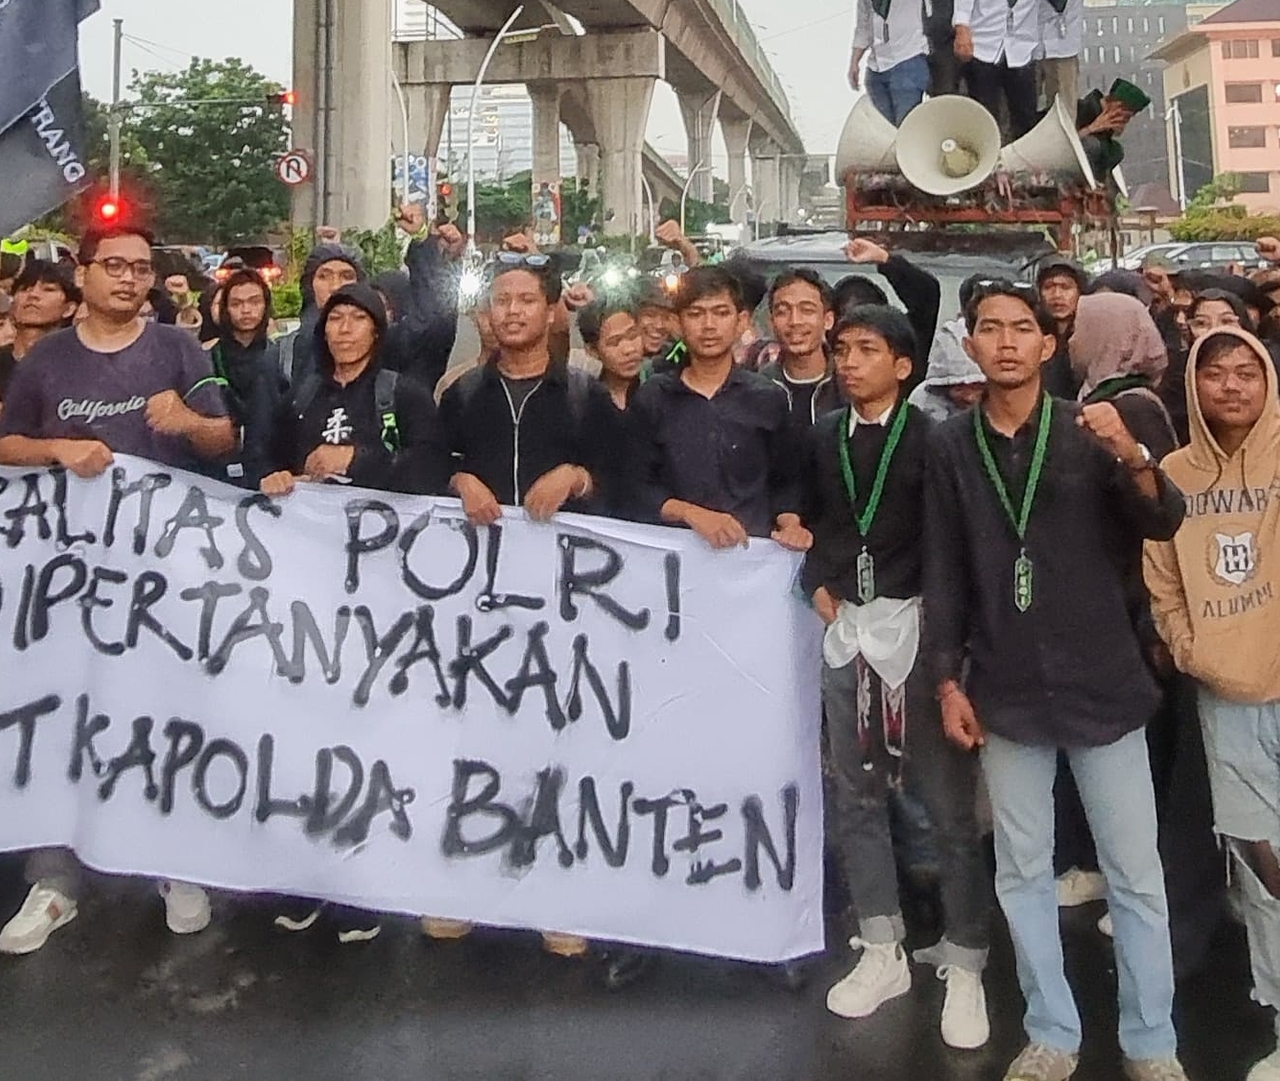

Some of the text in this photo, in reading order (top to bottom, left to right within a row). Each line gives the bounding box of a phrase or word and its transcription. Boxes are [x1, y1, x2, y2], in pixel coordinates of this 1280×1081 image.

[31, 99, 86, 183] RANG
[57, 395, 146, 424] California
[1202, 581, 1275, 619] ALUMNI
[66, 694, 416, 850] KAPOLDA
[439, 758, 800, 892] BANTEN
